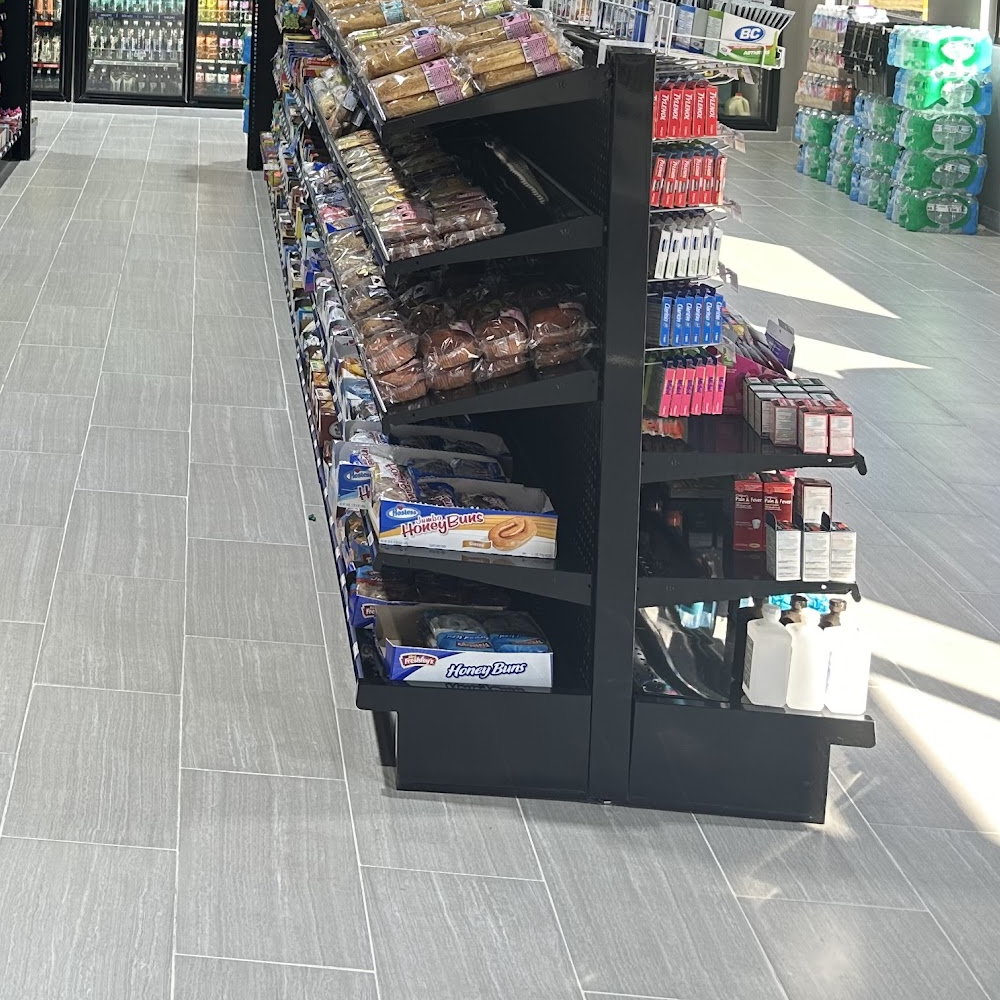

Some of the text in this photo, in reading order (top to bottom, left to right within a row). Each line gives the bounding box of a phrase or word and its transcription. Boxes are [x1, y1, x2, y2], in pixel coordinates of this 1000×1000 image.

[739, 28, 763, 40] BC
[391, 508, 418, 518] Hostess
[414, 514, 442, 525] Jumbo
[446, 662, 528, 679] Honey Buns
